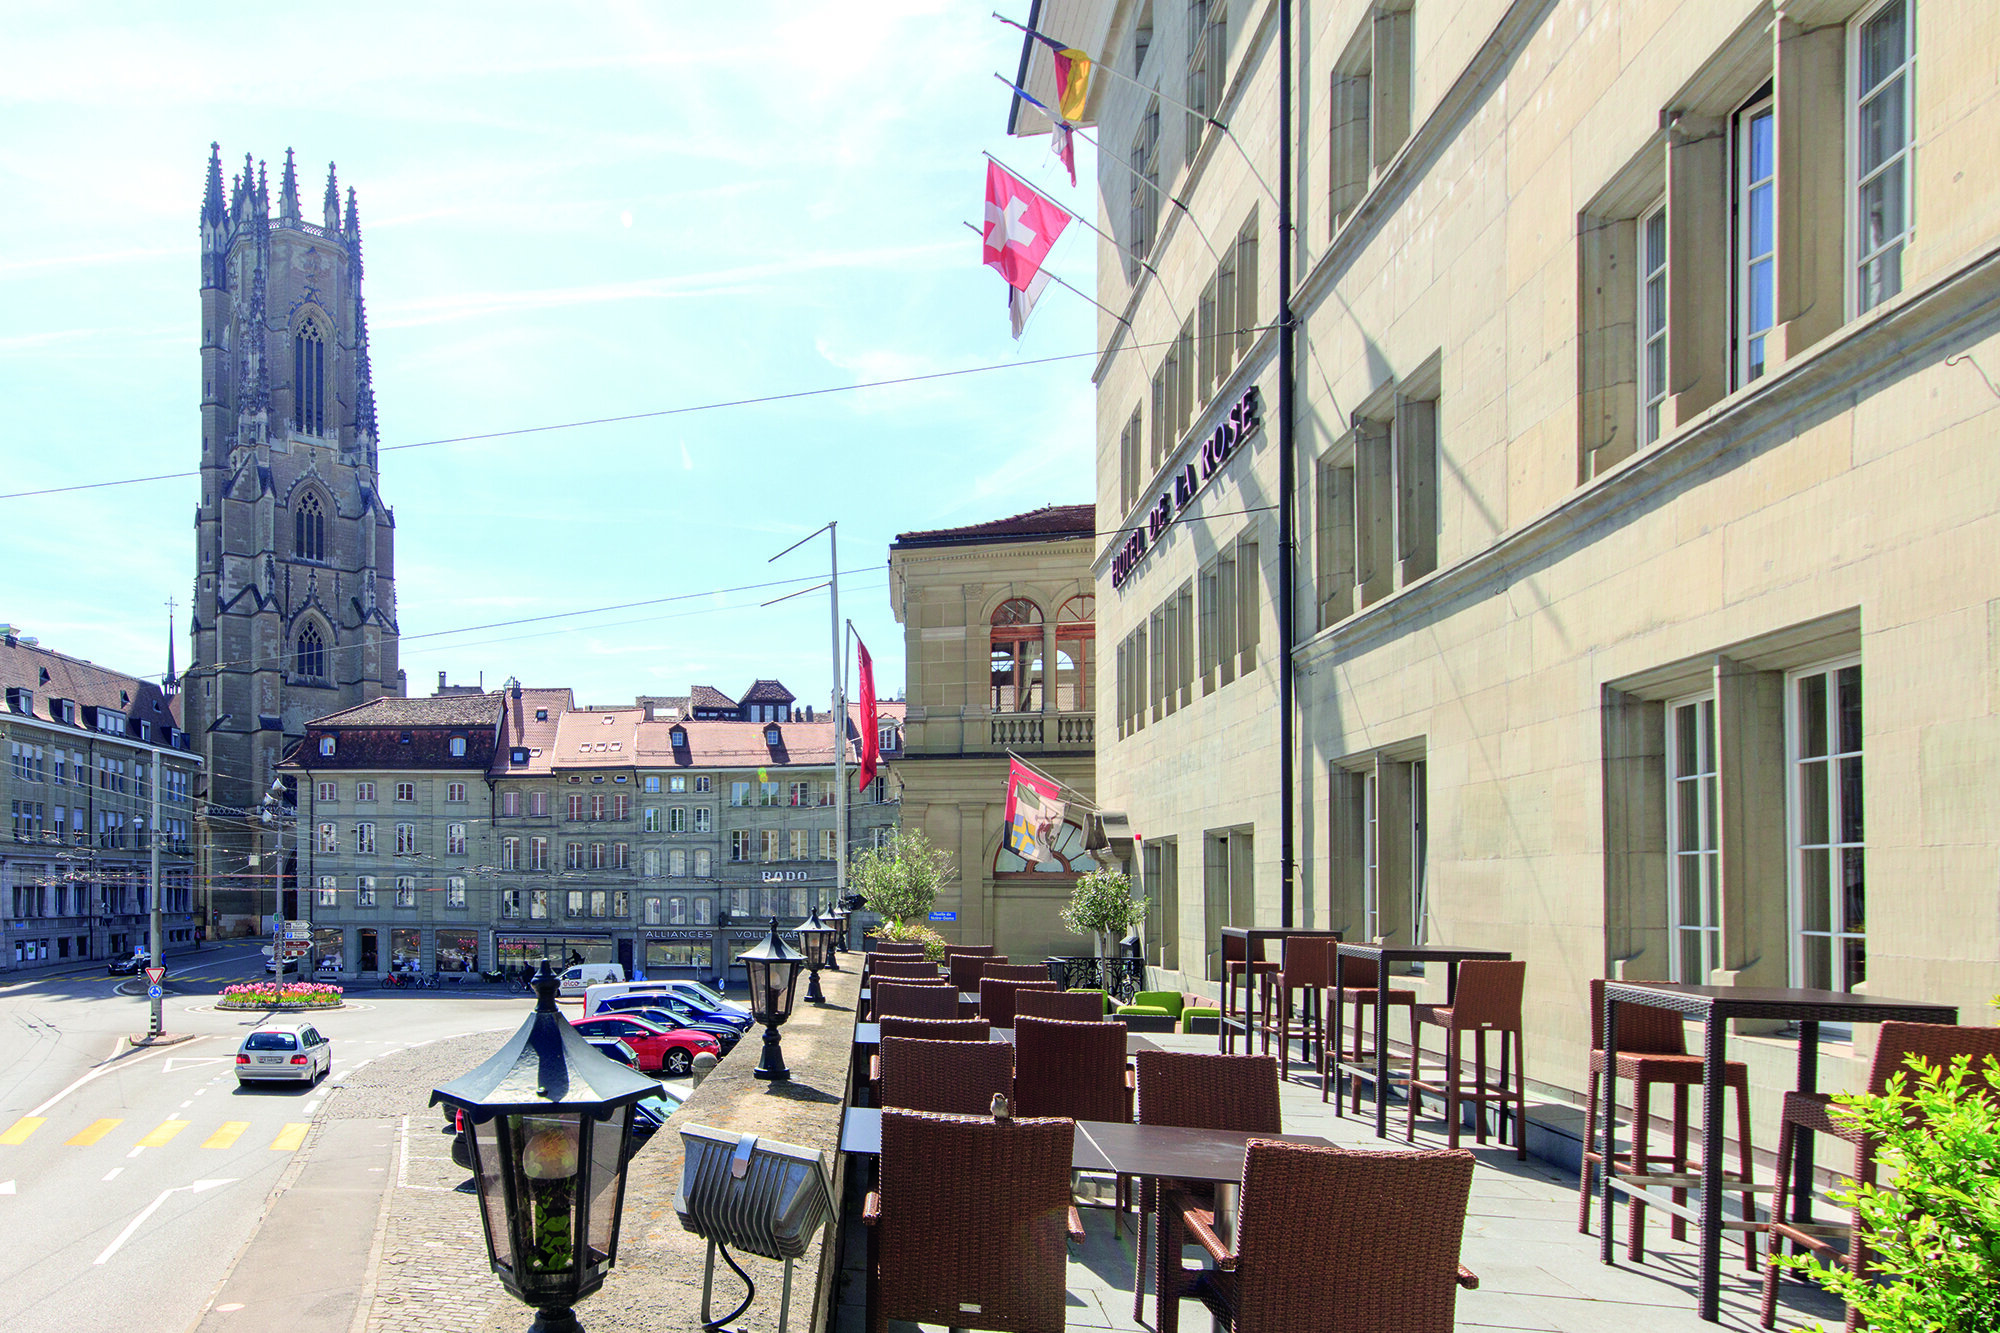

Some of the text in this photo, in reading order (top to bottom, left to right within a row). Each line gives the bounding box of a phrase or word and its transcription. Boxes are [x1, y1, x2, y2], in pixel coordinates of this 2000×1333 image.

[1111, 385, 1260, 588] HOTEL DE LA ROSE
[761, 871, 808, 882] RADO
[645, 930, 713, 938] ALLIANCES
